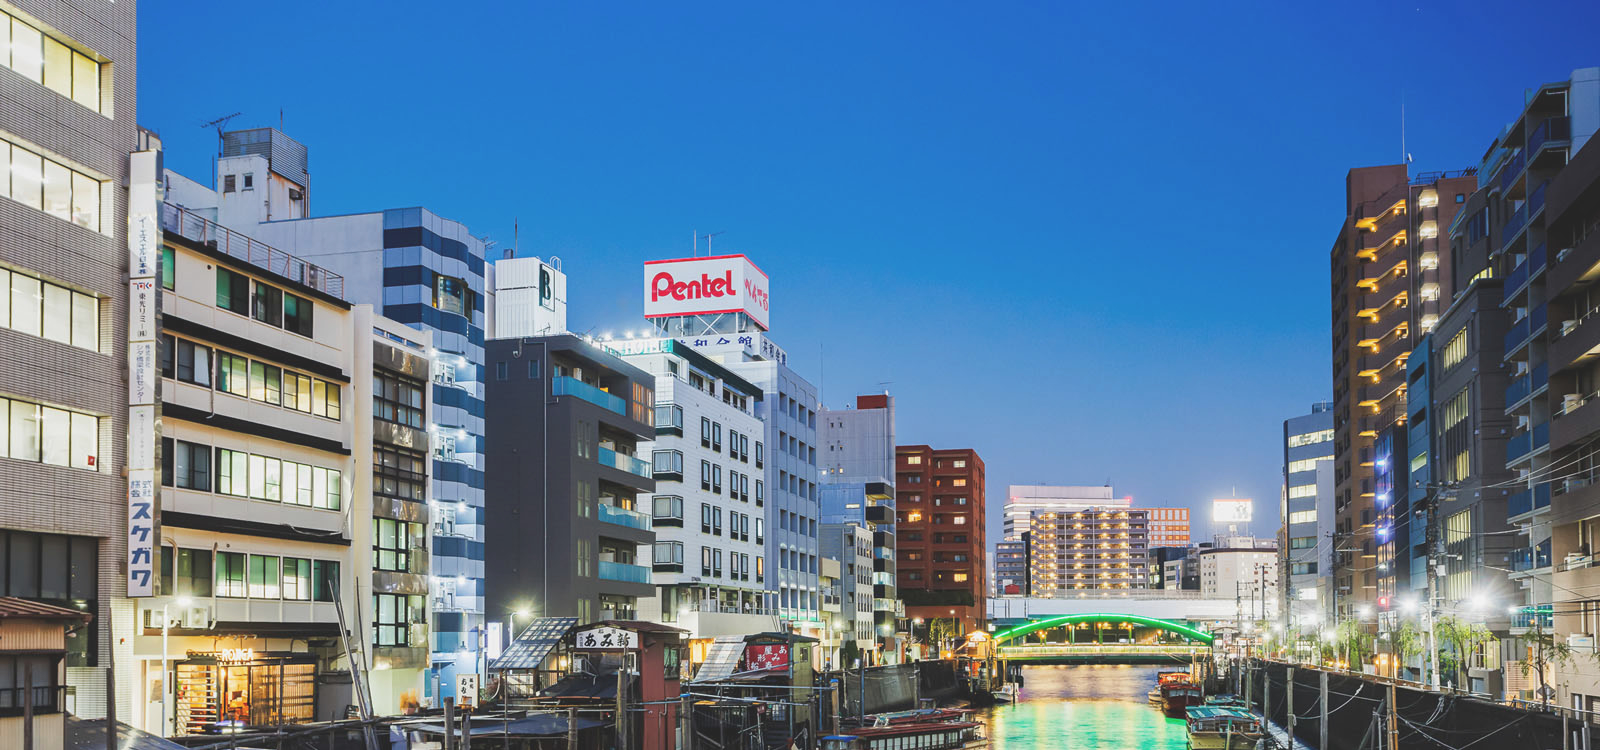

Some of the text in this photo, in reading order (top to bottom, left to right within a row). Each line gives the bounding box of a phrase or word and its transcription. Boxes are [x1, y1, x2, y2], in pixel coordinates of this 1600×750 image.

[651, 270, 737, 302] Pentel
[680, 336, 753, 348] 和会館
[131, 502, 151, 588] スケガワ
